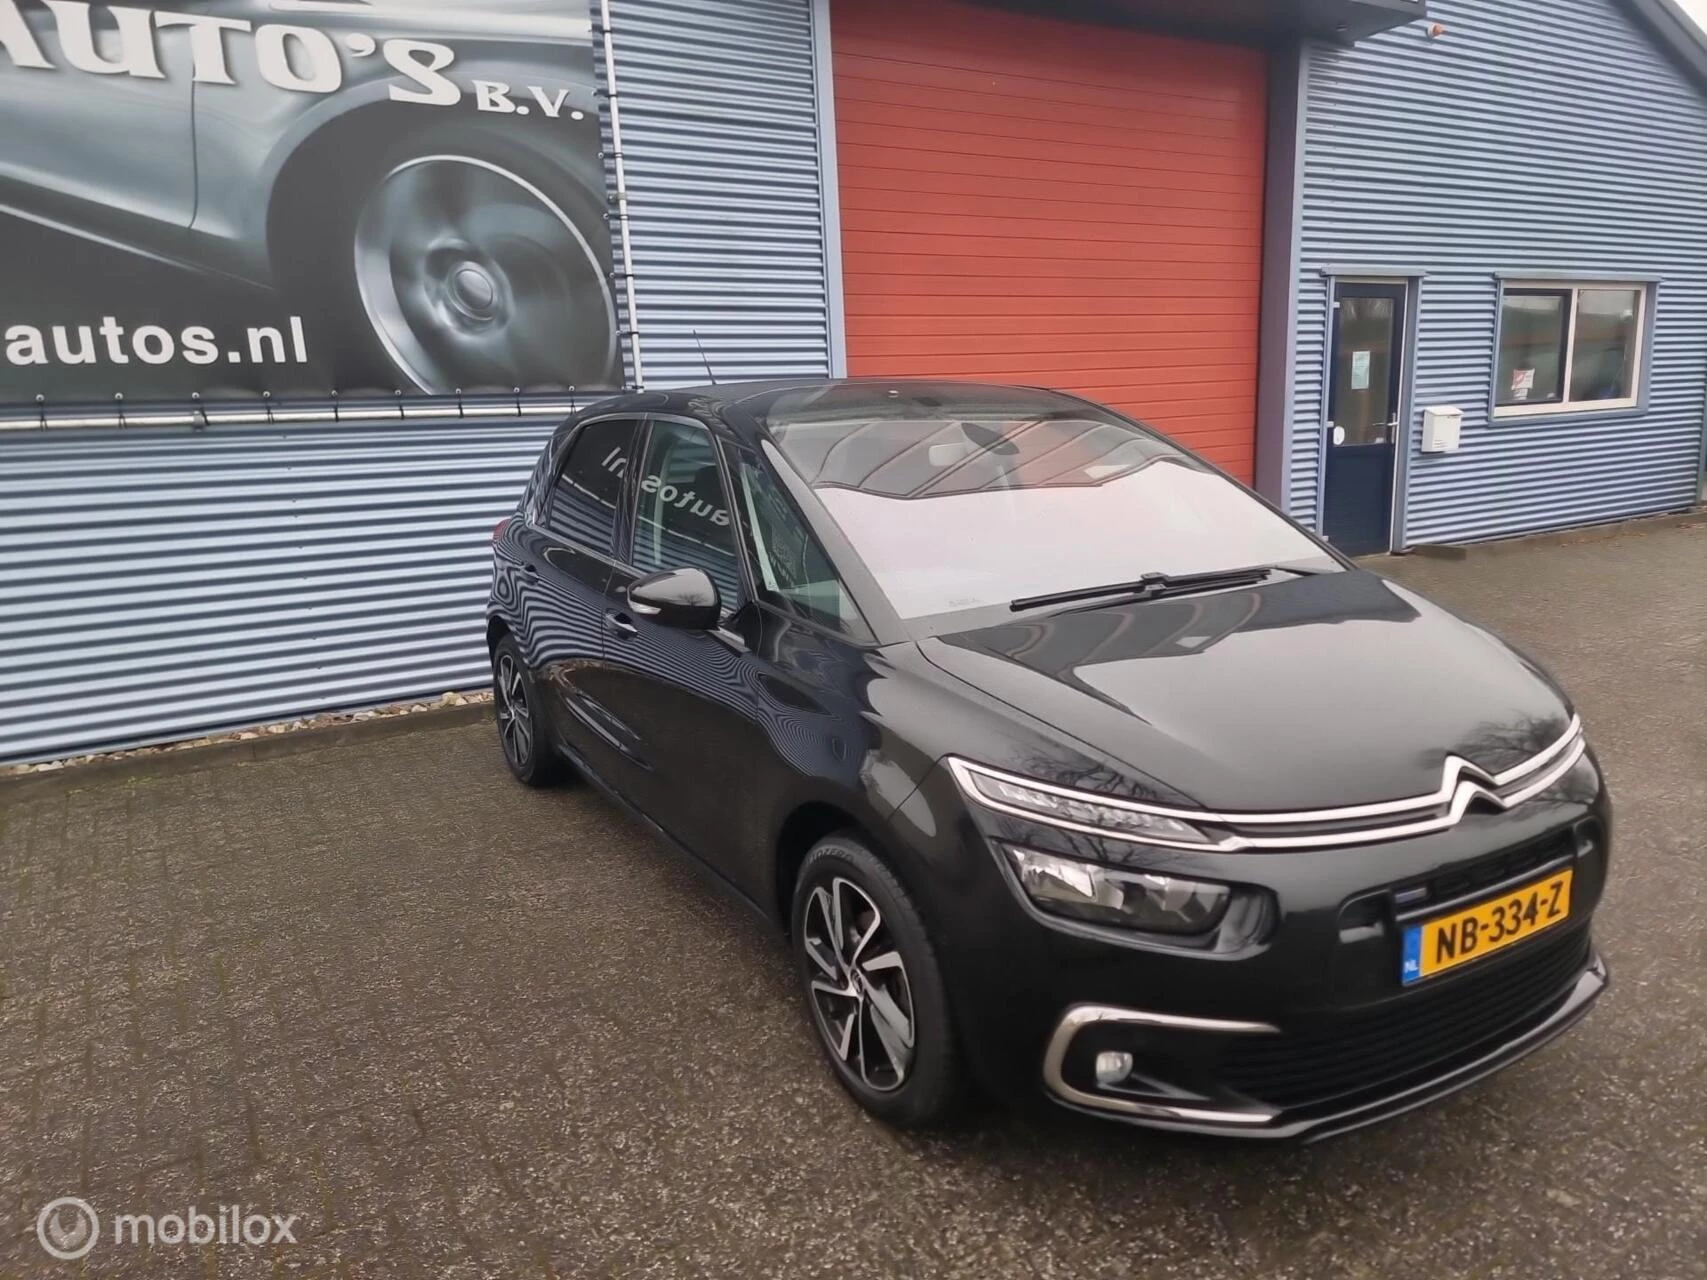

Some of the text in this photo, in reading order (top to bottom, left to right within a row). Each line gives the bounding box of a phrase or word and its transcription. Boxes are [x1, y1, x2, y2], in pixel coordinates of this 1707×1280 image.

[471, 79, 585, 121] B.V.
[4, 316, 308, 366] autos.nl
[1435, 880, 1564, 964] NB-334-Z
[1404, 959, 1418, 974] NL
